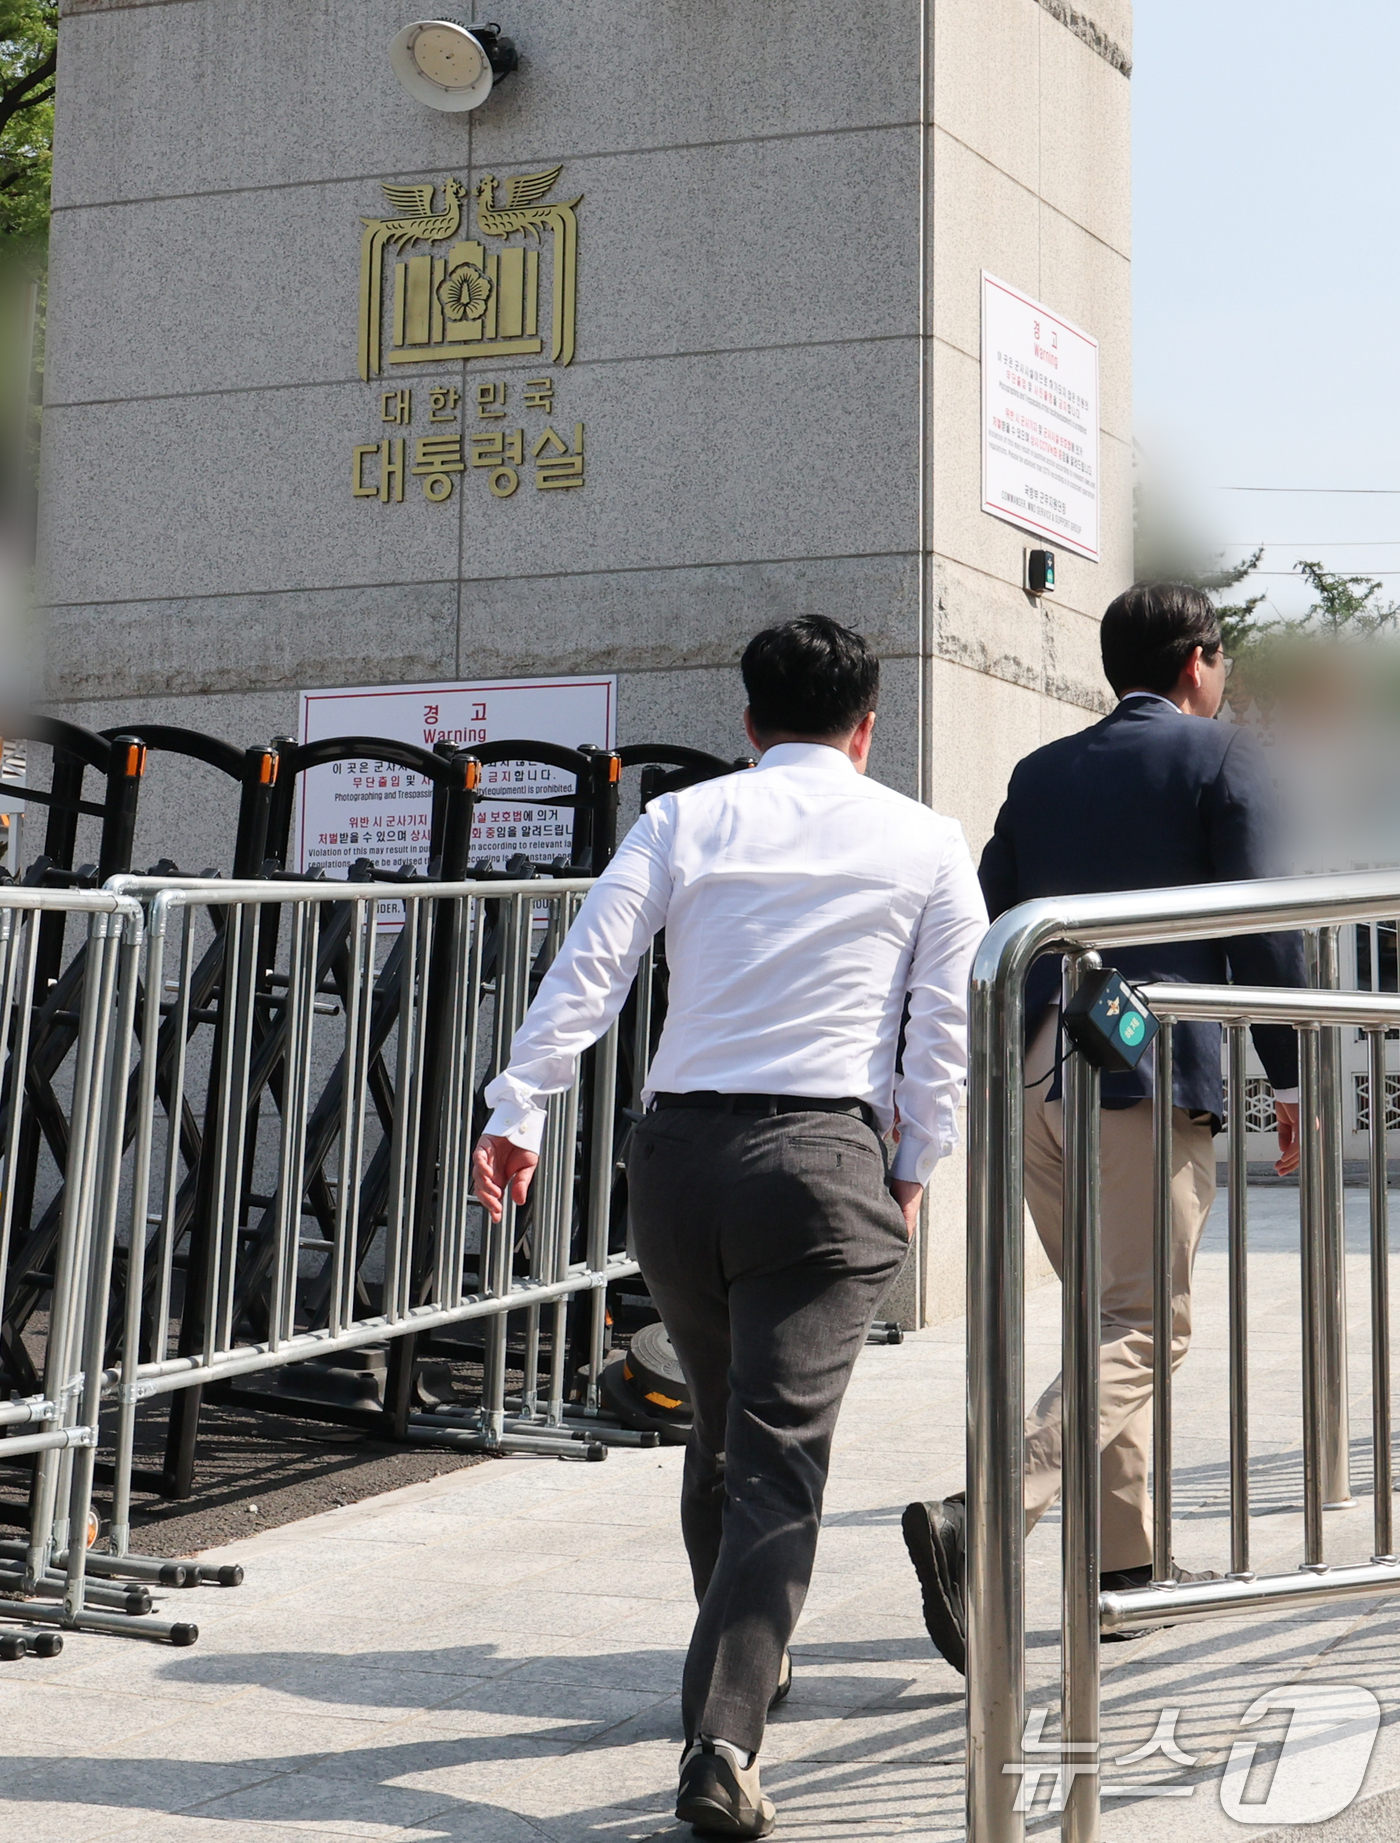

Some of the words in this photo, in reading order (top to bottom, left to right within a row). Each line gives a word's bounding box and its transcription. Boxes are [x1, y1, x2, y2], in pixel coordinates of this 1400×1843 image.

[1034, 342, 1058, 369] Warning
[381, 378, 553, 424] 대한민국
[353, 423, 584, 503] 대통령실
[423, 727, 487, 743] Warning
[333, 763, 342, 774] 이
[348, 762, 369, 774] 곳은
[353, 775, 400, 788] 무단출입
[406, 775, 415, 787] 및
[489, 769, 556, 783] 금지합니다.
[334, 790, 382, 801] Photographing
[384, 790, 397, 800] and
[527, 785, 534, 795] is
[535, 783, 574, 795] prohibited.
[349, 816, 370, 829] 위반
[373, 816, 382, 828] 시
[386, 814, 427, 828] 군사기지
[491, 810, 533, 824] 보호법에
[537, 809, 558, 821] 의거
[318, 832, 359, 845] 처벌받을
[363, 832, 372, 843] 수
[376, 830, 407, 843] 있으며
[486, 826, 517, 839] 중임을
[308, 848, 341, 857] Violation
[343, 847, 351, 856] of
[353, 846, 368, 856] this
[369, 847, 384, 858] may
[386, 845, 409, 854] result
[410, 844, 416, 853] in
[478, 842, 517, 853] according
[519, 841, 527, 850] to
[529, 839, 562, 850] relevant
[382, 858, 390, 867] be
